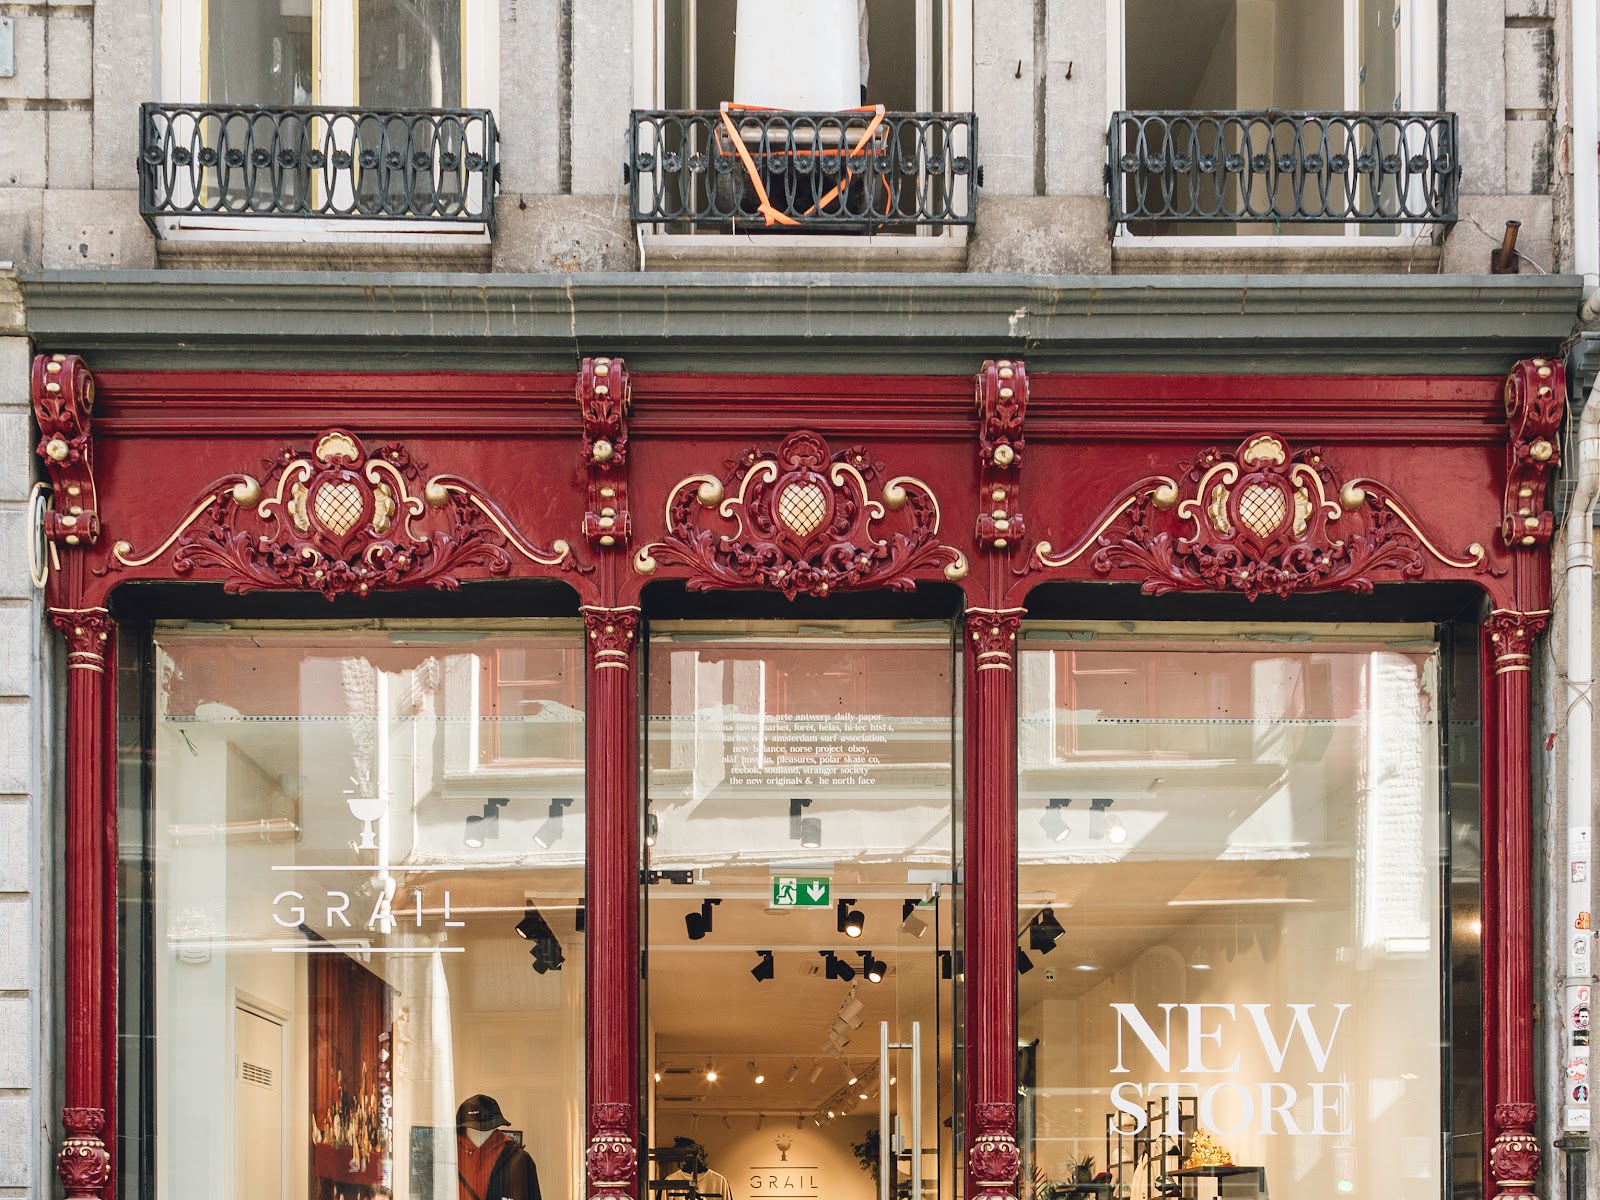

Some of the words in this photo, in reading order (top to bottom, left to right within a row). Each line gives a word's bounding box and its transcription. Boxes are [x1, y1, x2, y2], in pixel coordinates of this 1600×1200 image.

[775, 713, 793, 721] arte
[795, 713, 831, 723] antwerp
[834, 712, 855, 723] daily
[858, 714, 883, 723] paper
[736, 723, 757, 731] town
[771, 734, 818, 742] amsterdam
[820, 733, 838, 742] surf
[840, 734, 887, 743] association,
[753, 745, 787, 754] blance,
[815, 745, 843, 754] project
[848, 745, 869, 754] obey,
[741, 755, 774, 764] hussin,
[777, 755, 817, 765] pleasures,
[819, 755, 841, 765] polar
[844, 755, 866, 763] skate
[868, 756, 880, 764] co,
[731, 766, 762, 775] reebok,
[803, 767, 838, 776] stranger
[840, 766, 869, 776] society
[730, 777, 743, 785] the
[766, 776, 803, 786] originals
[805, 777, 813, 785] &
[832, 777, 855, 785] north
[858, 776, 876, 785] face
[272, 890, 465, 927] GRAIL
[1110, 1003, 1352, 1073] NEW
[1110, 1081, 1352, 1137] STORE
[750, 1175, 818, 1189] GRAIL
